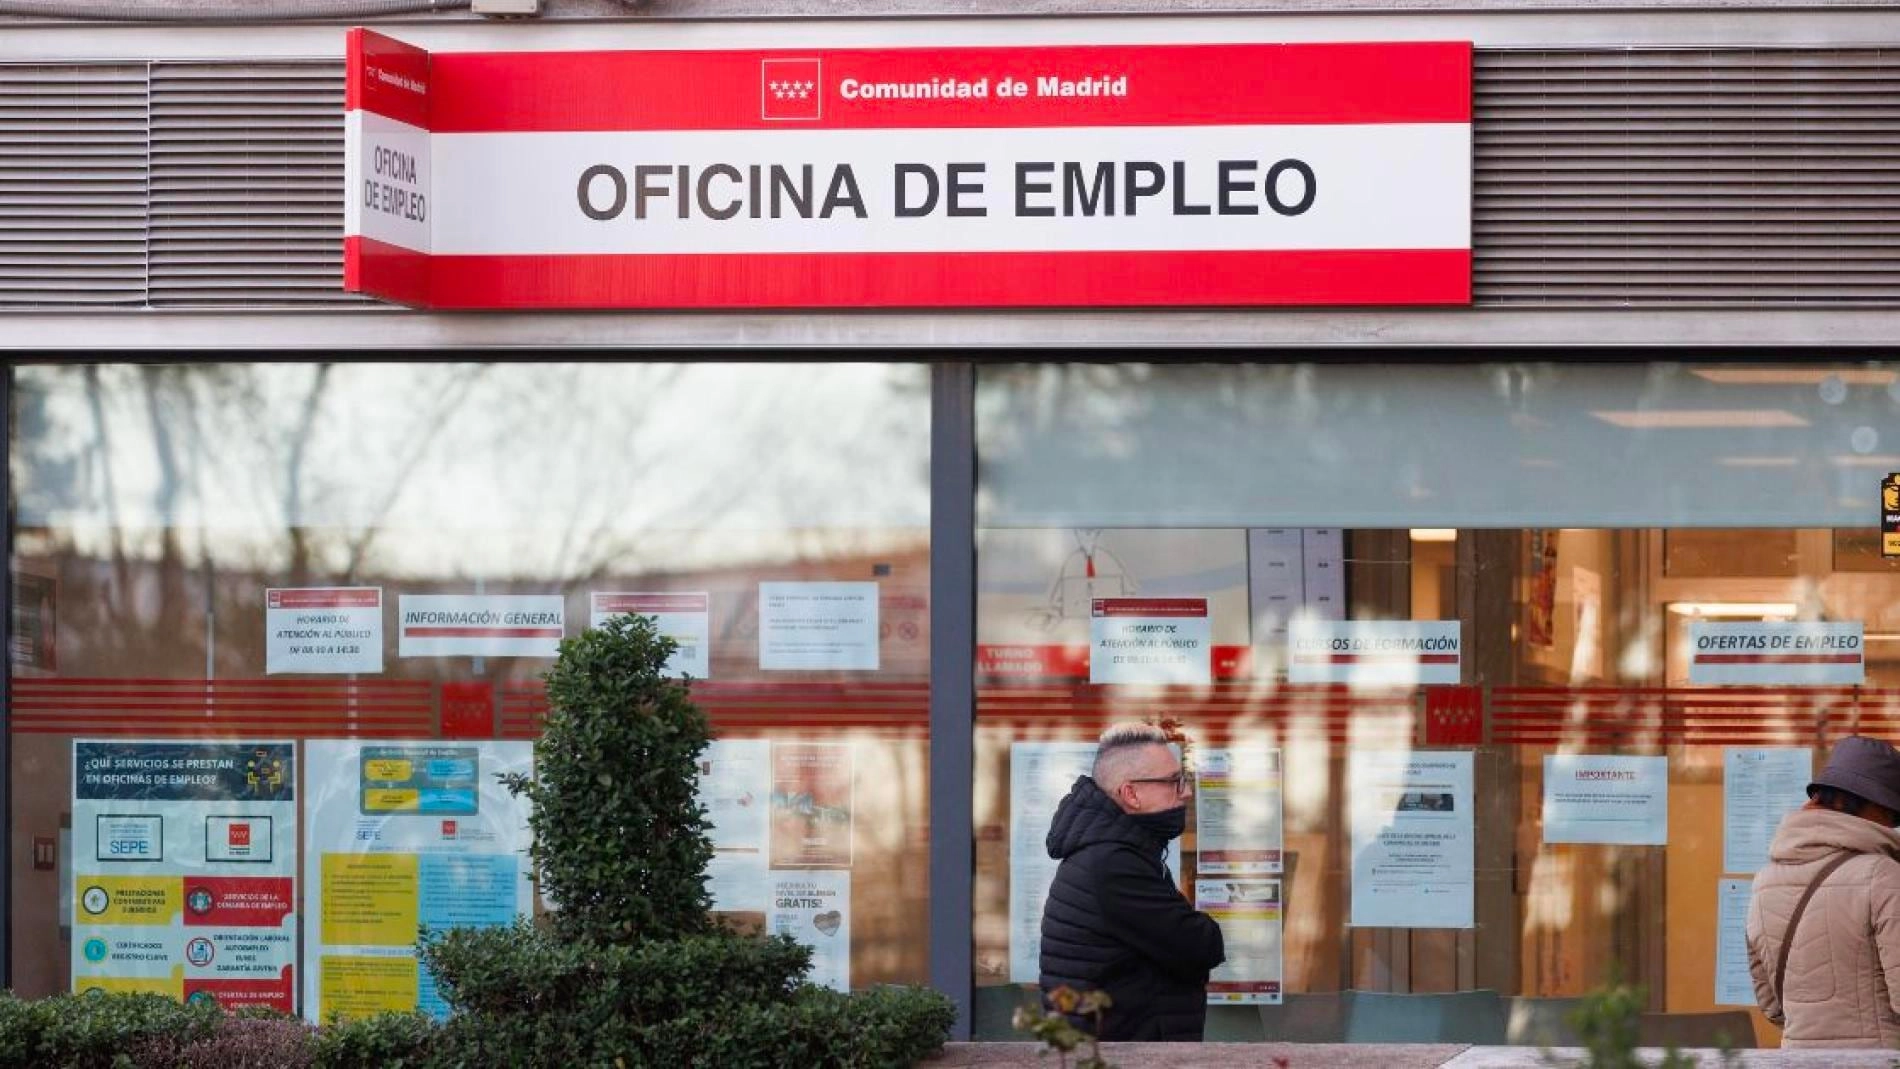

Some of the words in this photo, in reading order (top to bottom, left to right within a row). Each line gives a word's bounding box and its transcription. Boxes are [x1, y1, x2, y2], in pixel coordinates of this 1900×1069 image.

[839, 77, 989, 99] Comunidad
[996, 77, 1028, 98] de
[1036, 76, 1128, 98] Madrid
[373, 145, 417, 185] OFICINA
[576, 162, 869, 221] OFICINA
[893, 161, 988, 218] DE
[1014, 157, 1318, 218] EMPLEO
[364, 179, 380, 211] DE
[381, 185, 426, 223] EMPLEO
[296, 615, 337, 625] HORARIO
[405, 610, 501, 625] INFORMACIÓN
[503, 611, 563, 625] GENERAL
[276, 628, 321, 639] ATENCIÓN
[322, 629, 333, 638] AL
[334, 628, 371, 639] PÚBLICO
[1121, 625, 1164, 634] HORARIO
[1099, 637, 1147, 649] ATENCIÓN
[1160, 637, 1199, 649] PÚBLICO
[1296, 637, 1350, 651] CURSOS
[1353, 637, 1372, 651] DE
[1374, 635, 1458, 651] FORMACIÓN
[1697, 635, 1767, 650] OFERTAS
[1770, 635, 1790, 649] DE
[1795, 635, 1859, 649] EMPLEO
[84, 755, 113, 770] ¿QUÉ
[114, 759, 169, 769] SERVICIOS
[172, 759, 185, 769] SE
[186, 759, 234, 769] PRESTAN
[86, 774, 99, 785] EN
[102, 774, 152, 785] OFICINAS
[154, 774, 168, 785] DE
[169, 774, 217, 785] EMPLEO?
[1575, 769, 1636, 780] IMPORTANTE
[109, 840, 149, 854] SEPE
